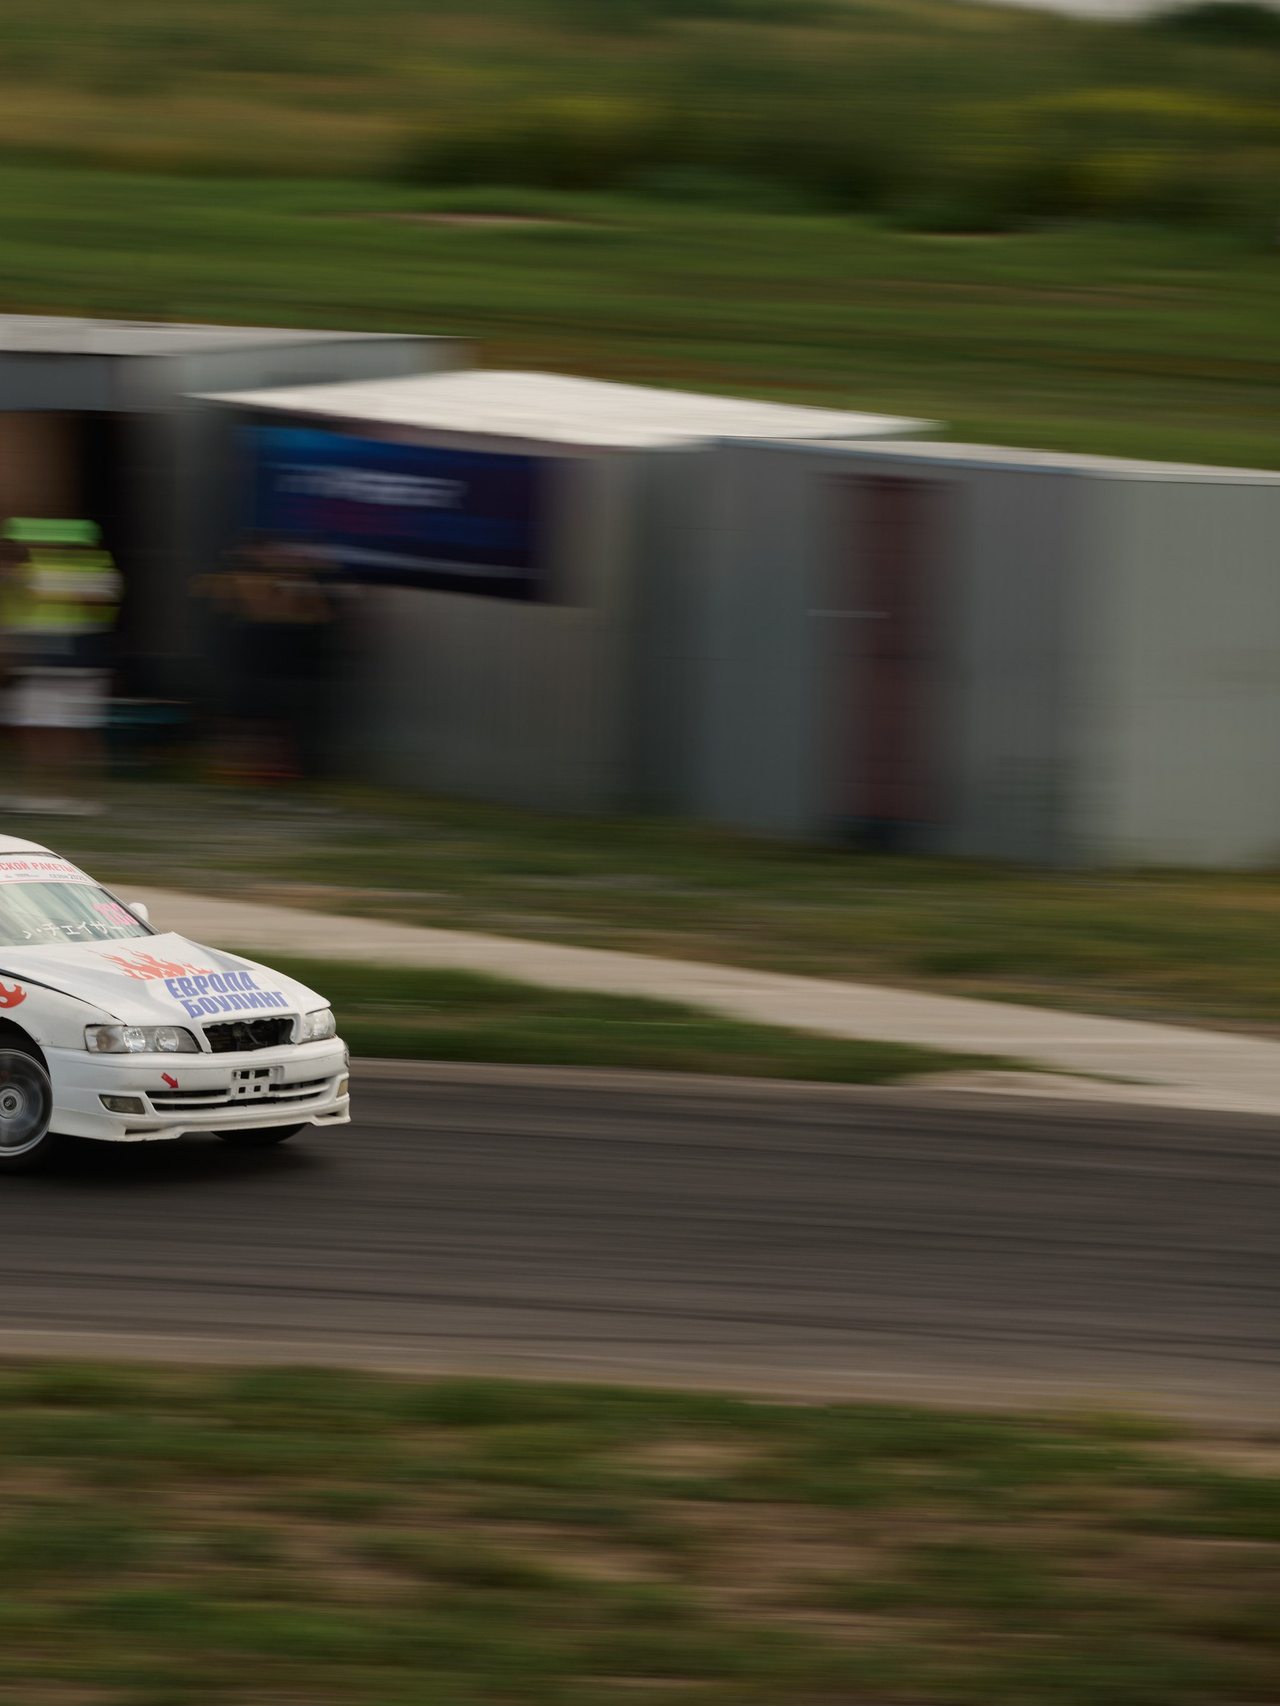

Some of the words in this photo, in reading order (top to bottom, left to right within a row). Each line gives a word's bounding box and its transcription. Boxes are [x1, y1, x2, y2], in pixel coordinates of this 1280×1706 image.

[31, 862, 76, 874] РАКЕТЫ
[164, 971, 261, 999] ЕВРОПА
[180, 991, 289, 1019] БОУЛИНГ
